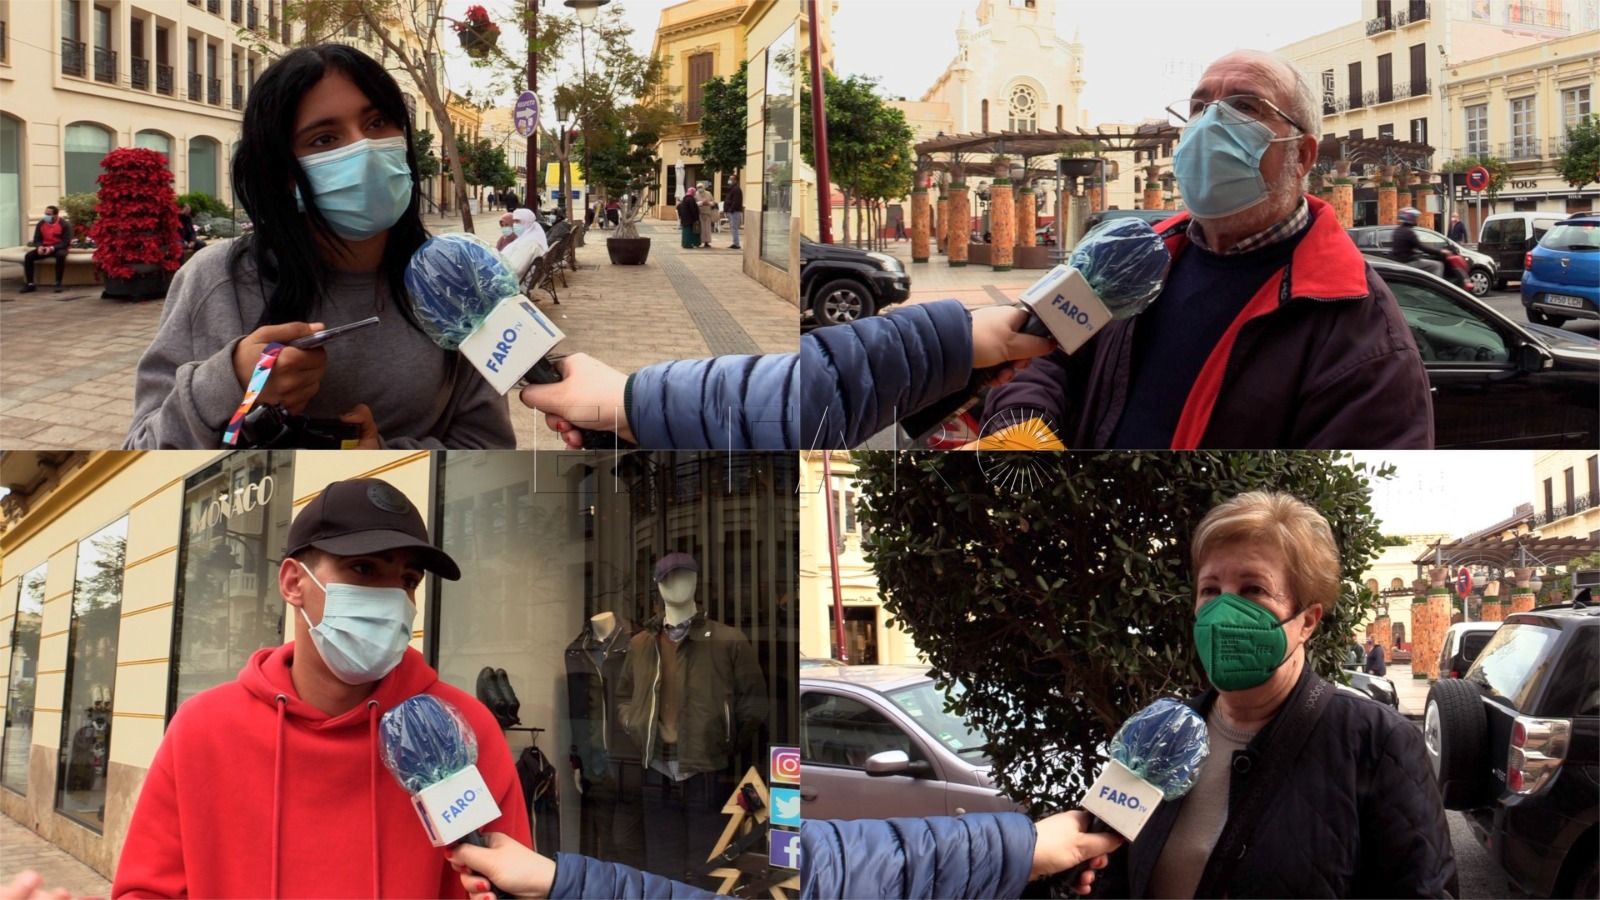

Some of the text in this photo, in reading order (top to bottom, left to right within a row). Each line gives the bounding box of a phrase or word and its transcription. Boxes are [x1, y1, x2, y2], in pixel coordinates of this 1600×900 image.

[1511, 180, 1537, 189] TOUS
[1051, 294, 1089, 325] FARO
[486, 328, 518, 373] FARO
[190, 475, 274, 534] MONACO
[441, 789, 476, 824] FARO
[1099, 785, 1140, 809] FARO
